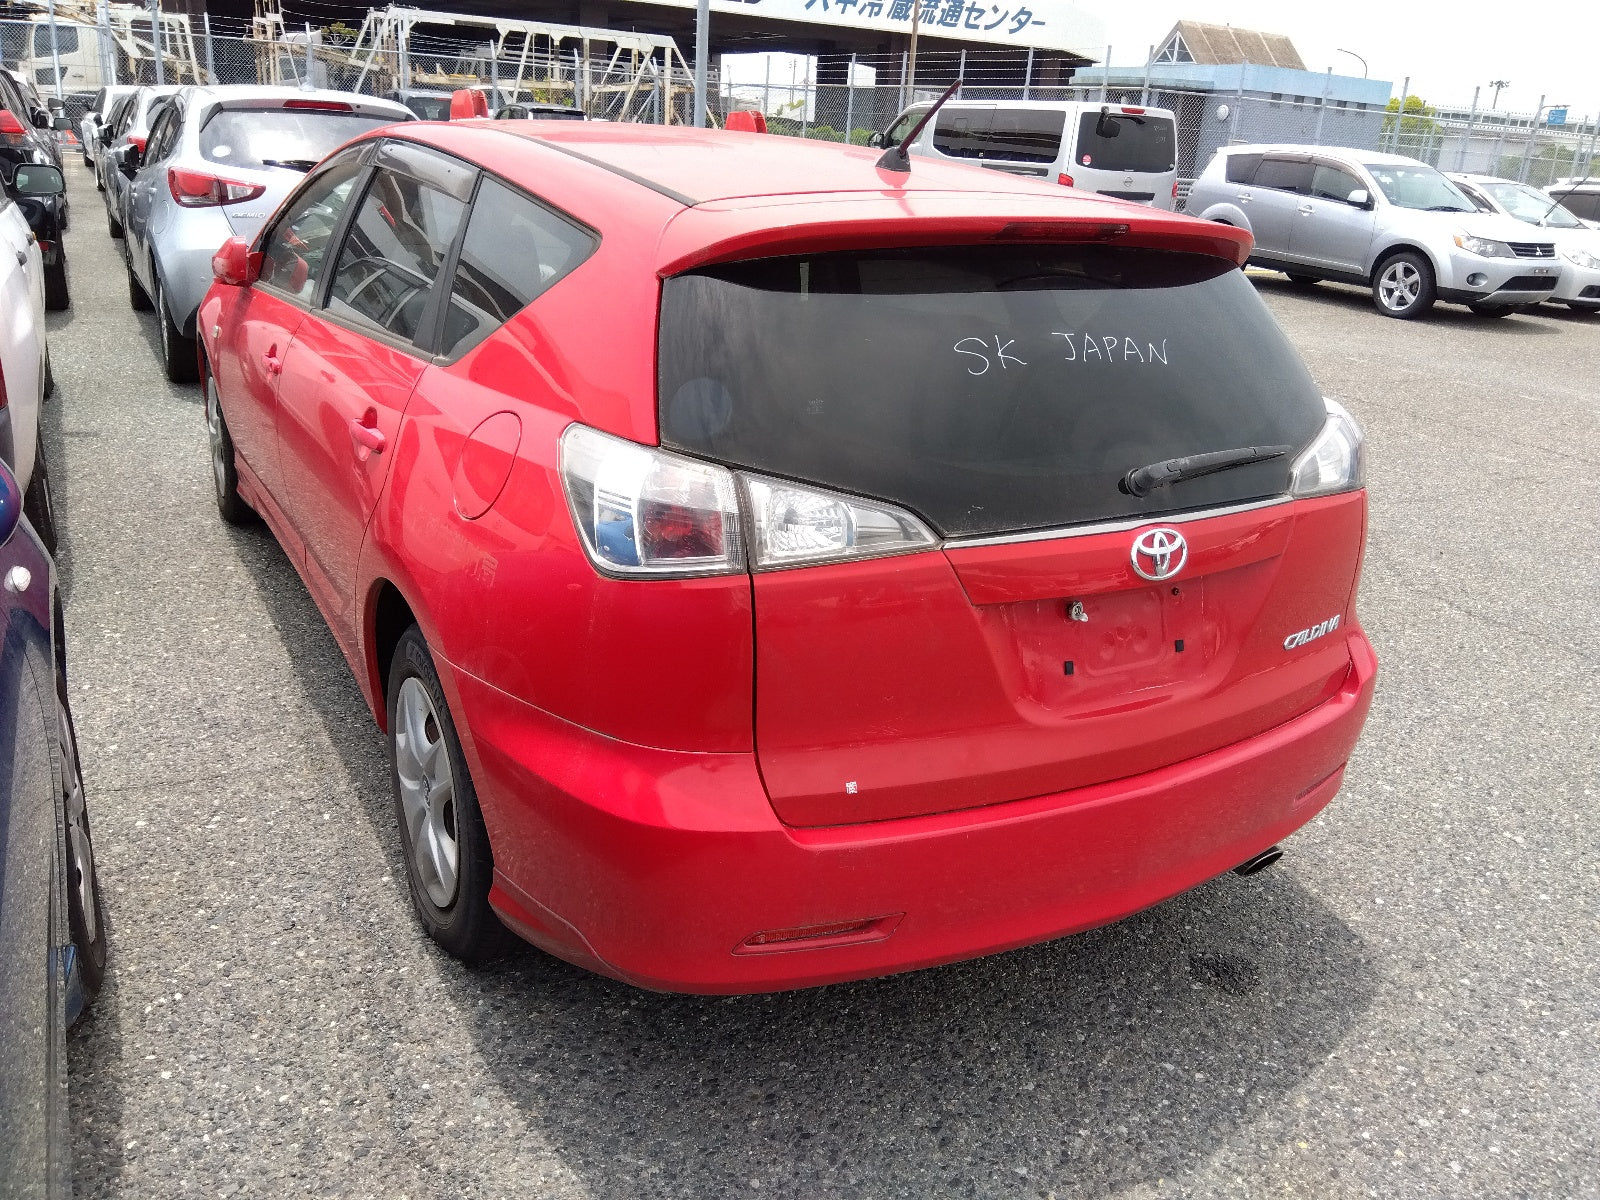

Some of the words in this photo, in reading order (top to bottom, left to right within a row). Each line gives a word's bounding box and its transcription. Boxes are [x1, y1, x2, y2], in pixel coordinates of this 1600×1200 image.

[953, 334, 1027, 375] SK
[1051, 332, 1167, 364] JAPAN
[1283, 614, 1340, 650] CALDINA
